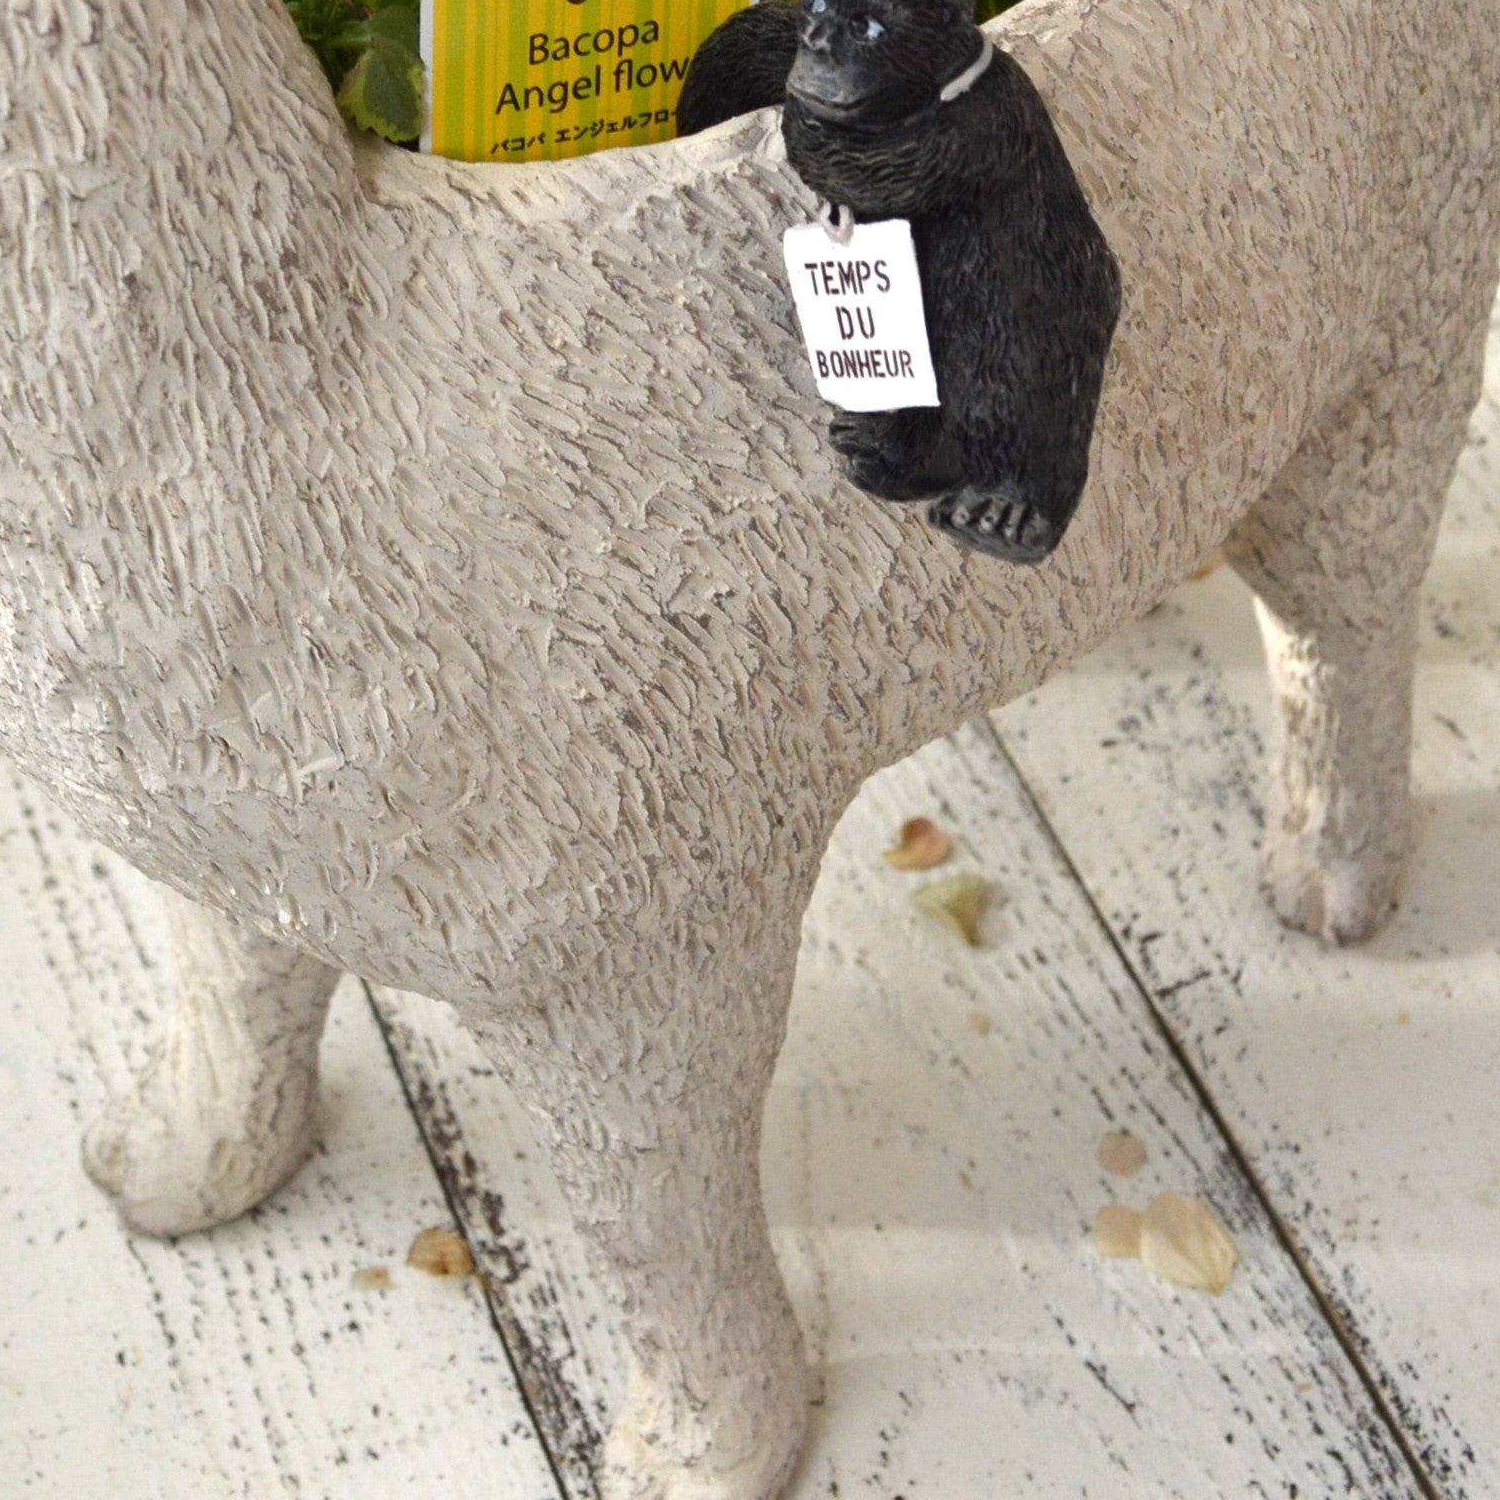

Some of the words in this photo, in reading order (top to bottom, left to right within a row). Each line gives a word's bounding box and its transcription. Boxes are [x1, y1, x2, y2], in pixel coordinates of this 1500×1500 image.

[529, 19, 660, 66] Bacopa
[495, 64, 602, 115] Angel
[612, 57, 691, 93] flow
[803, 259, 891, 296] TEMPS
[835, 305, 876, 341] DU
[815, 349, 915, 379] BONHEUR
